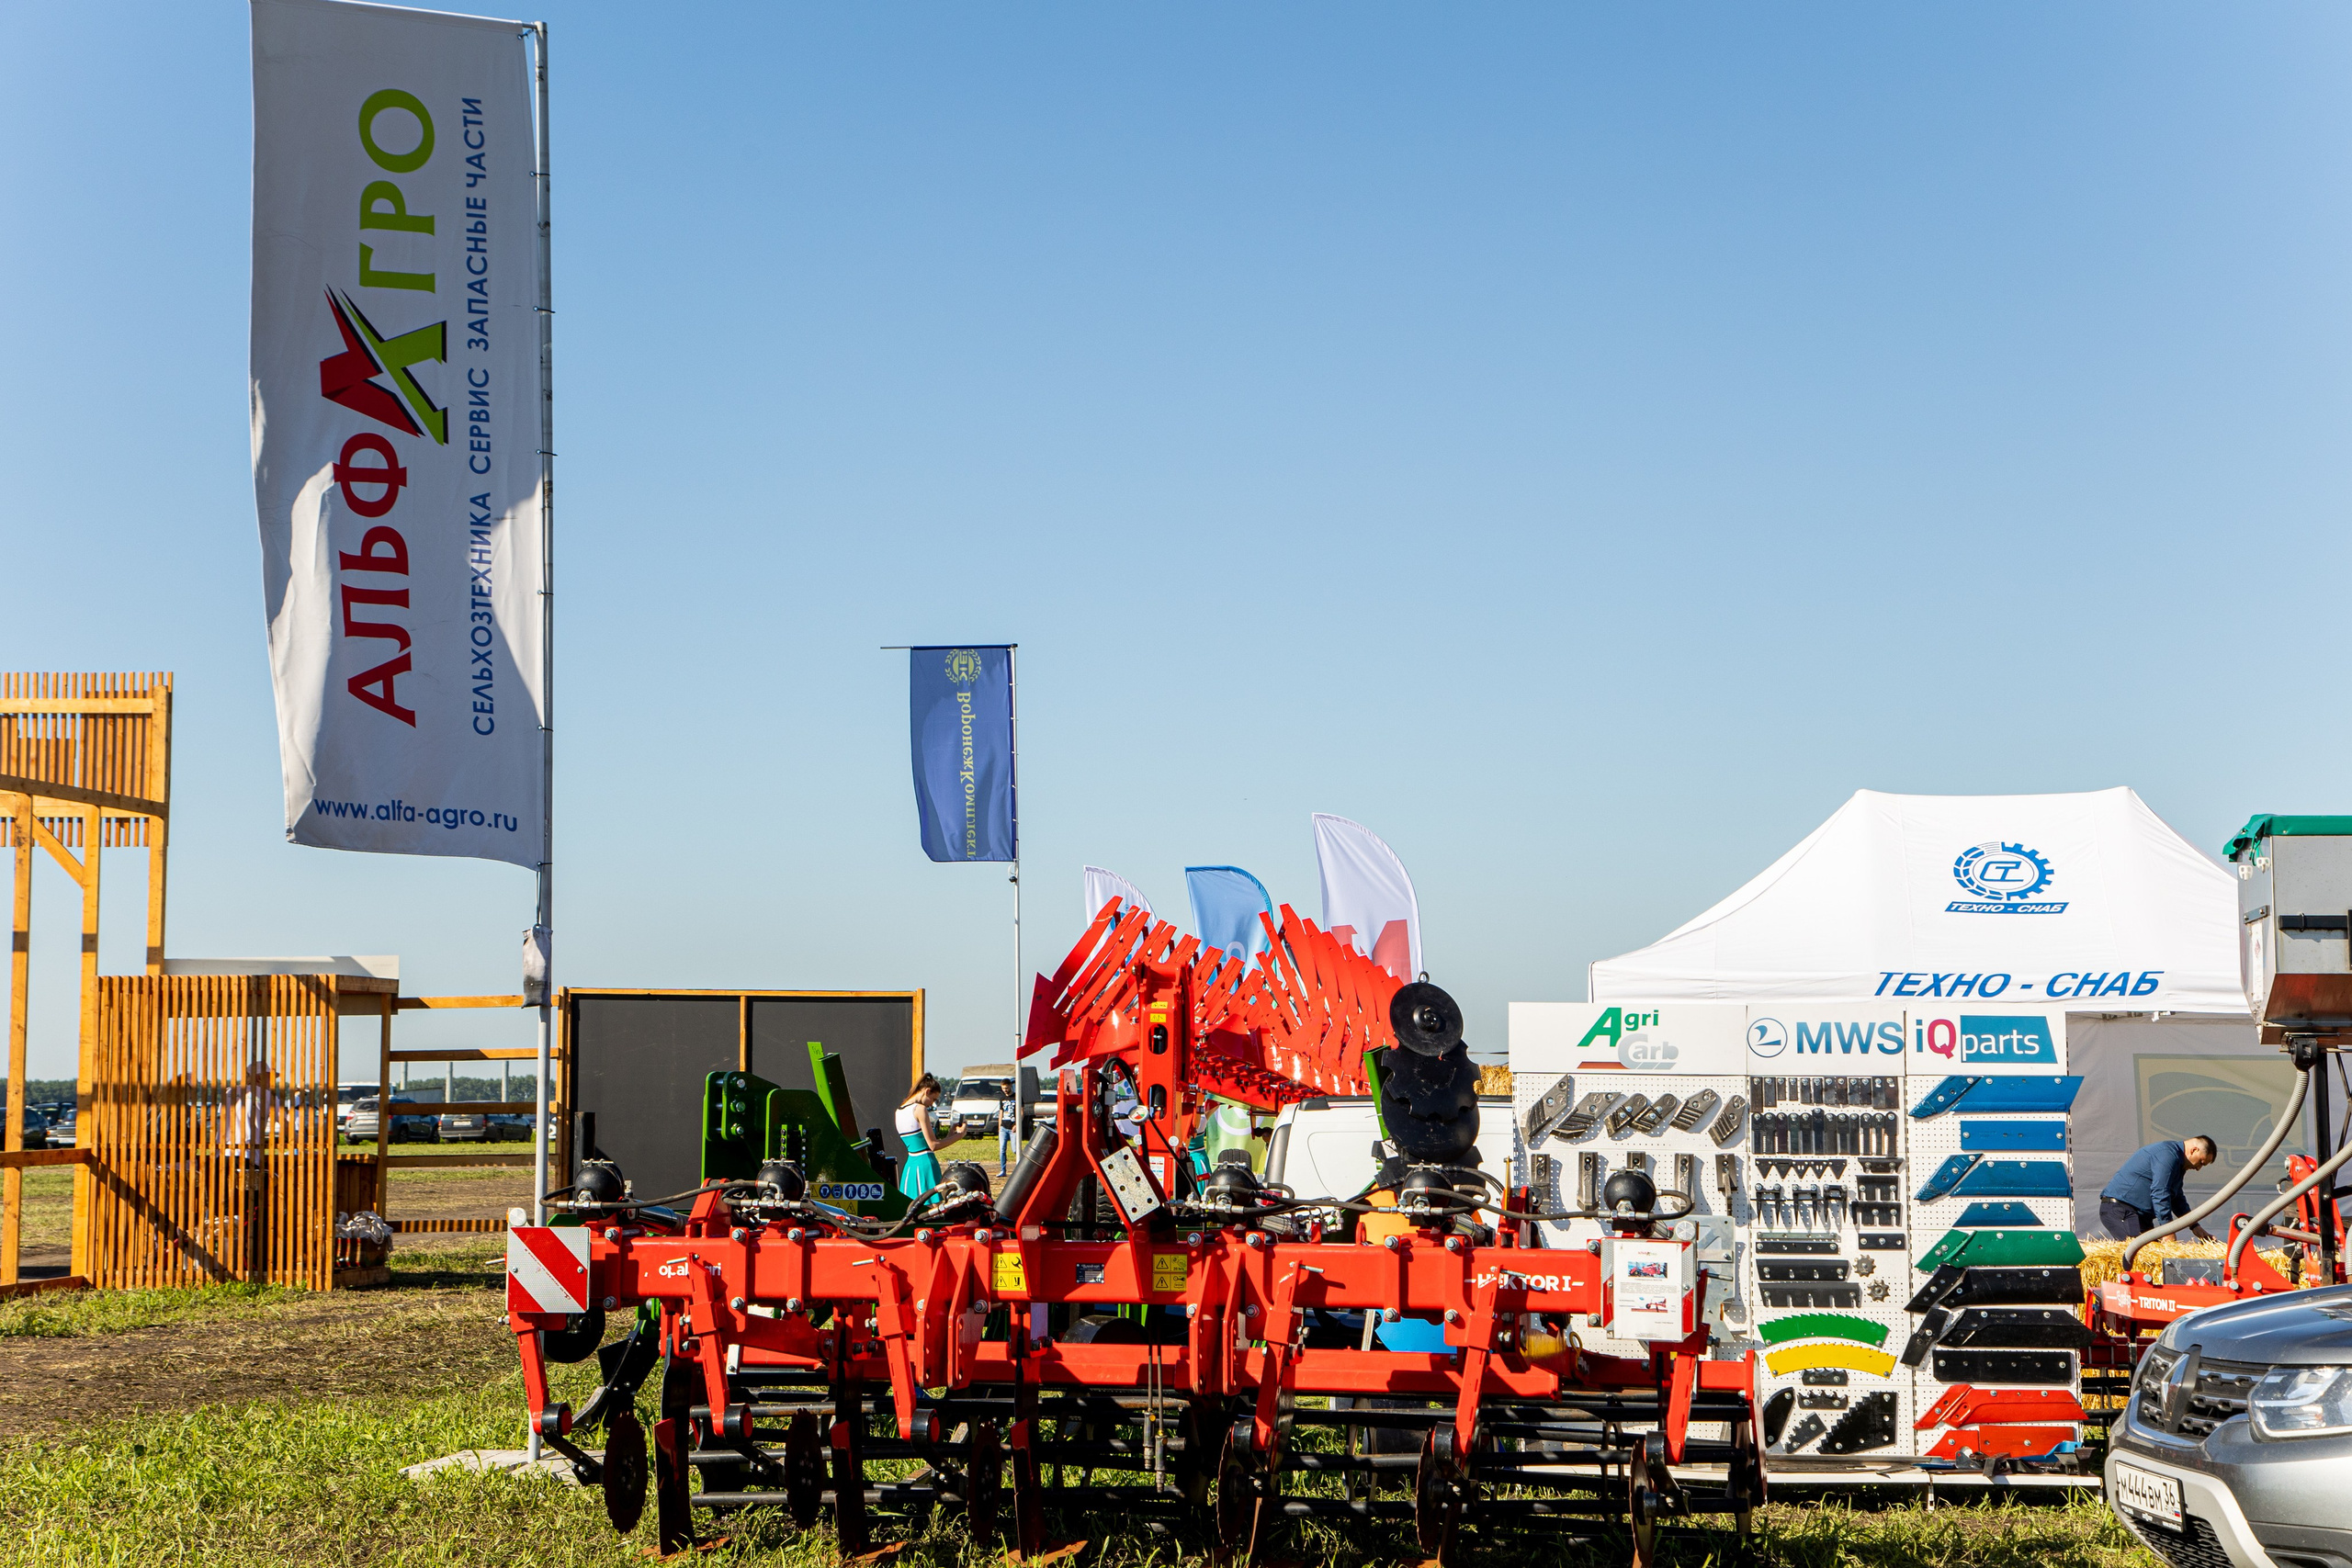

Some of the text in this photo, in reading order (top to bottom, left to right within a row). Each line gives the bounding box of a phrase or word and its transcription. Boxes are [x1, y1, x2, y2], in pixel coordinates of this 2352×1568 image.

[461, 97, 495, 736] СЕЛЬХОЗТЕХНИКА СЕРВИС ЗАПАСНЫЕ ЧАСТИ
[313, 797, 518, 833] www.alfa-agro.ru
[1951, 903, 2005, 913] ТЕХНО
[2017, 904, 2065, 913] СНАБ
[1873, 971, 2012, 998] ТЕХНО
[2045, 970, 2165, 998] СНАБ
[1576, 1007, 1659, 1047] Agri
[1796, 1021, 1905, 1055] MWS
[1617, 1032, 1679, 1070] Carb
[2138, 1296, 2168, 1312] TRITON
